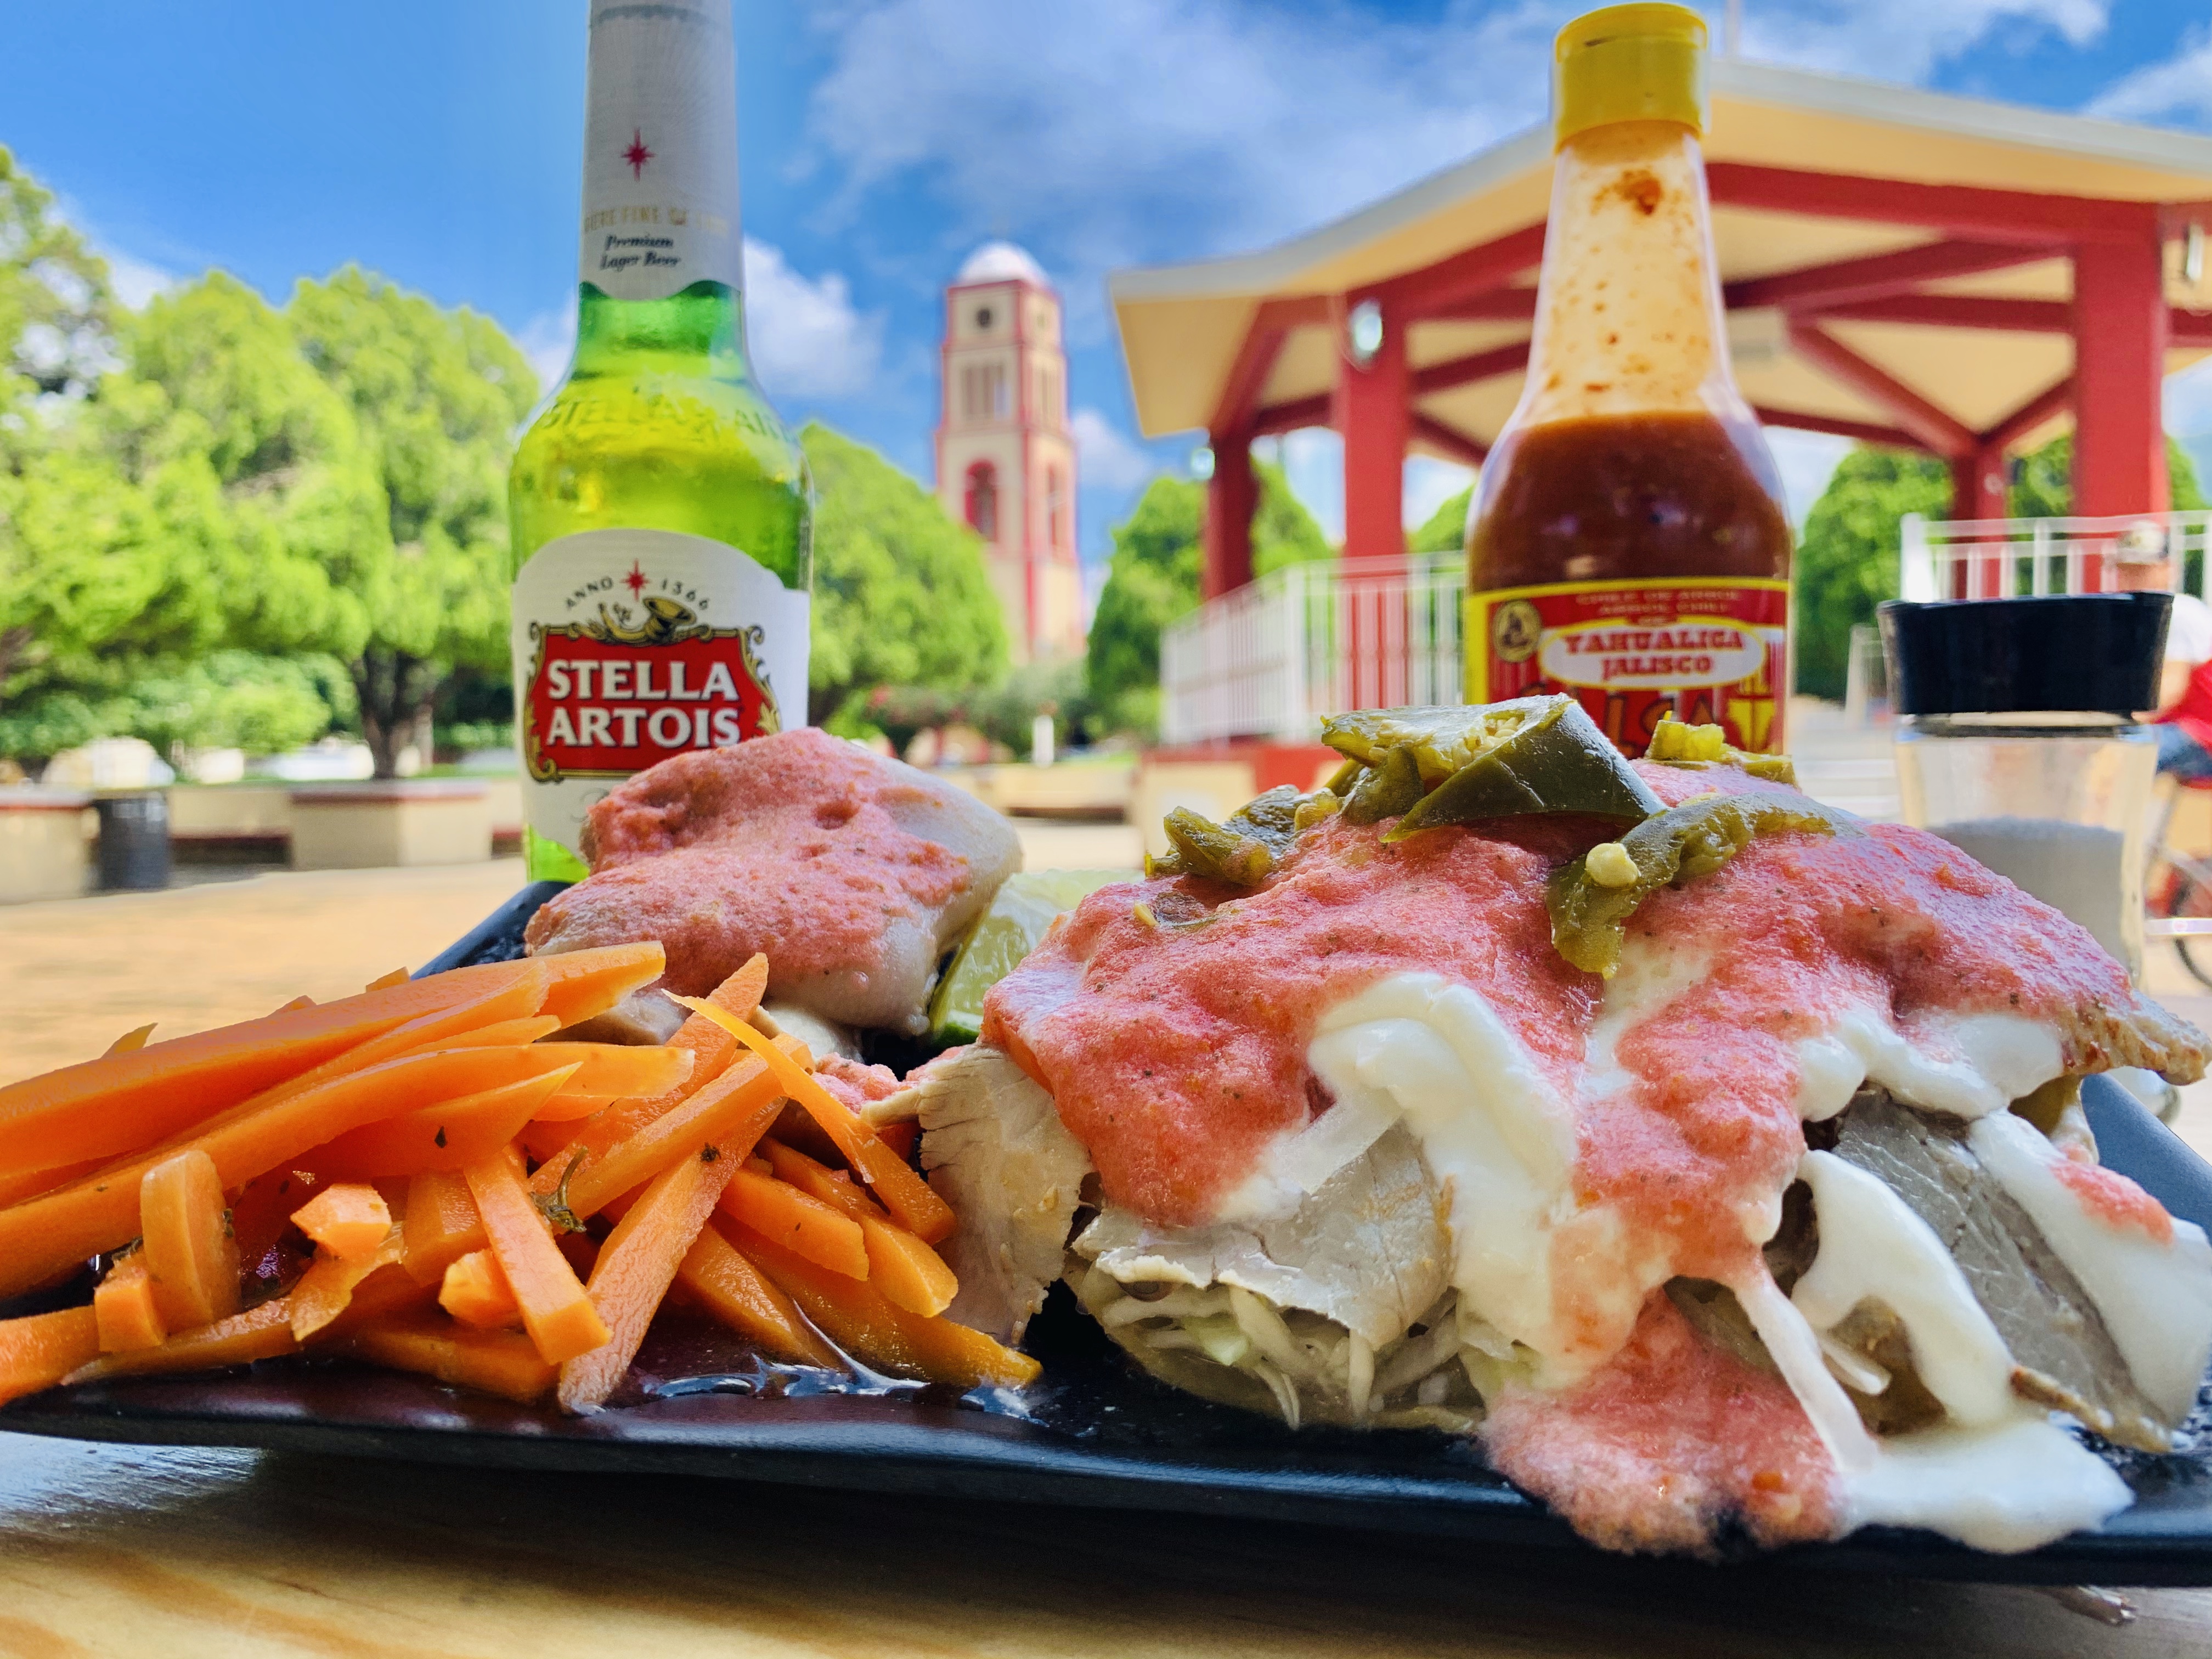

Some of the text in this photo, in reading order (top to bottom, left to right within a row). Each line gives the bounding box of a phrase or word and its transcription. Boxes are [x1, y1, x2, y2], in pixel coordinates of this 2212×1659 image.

[605, 233, 674, 251] Premium
[600, 250, 681, 272] Lager Beer
[566, 577, 709, 610] ANNO 1366
[548, 659, 740, 701] STELLA
[1601, 654, 1713, 681] JALISCO
[546, 707, 741, 748] ARTOIS
